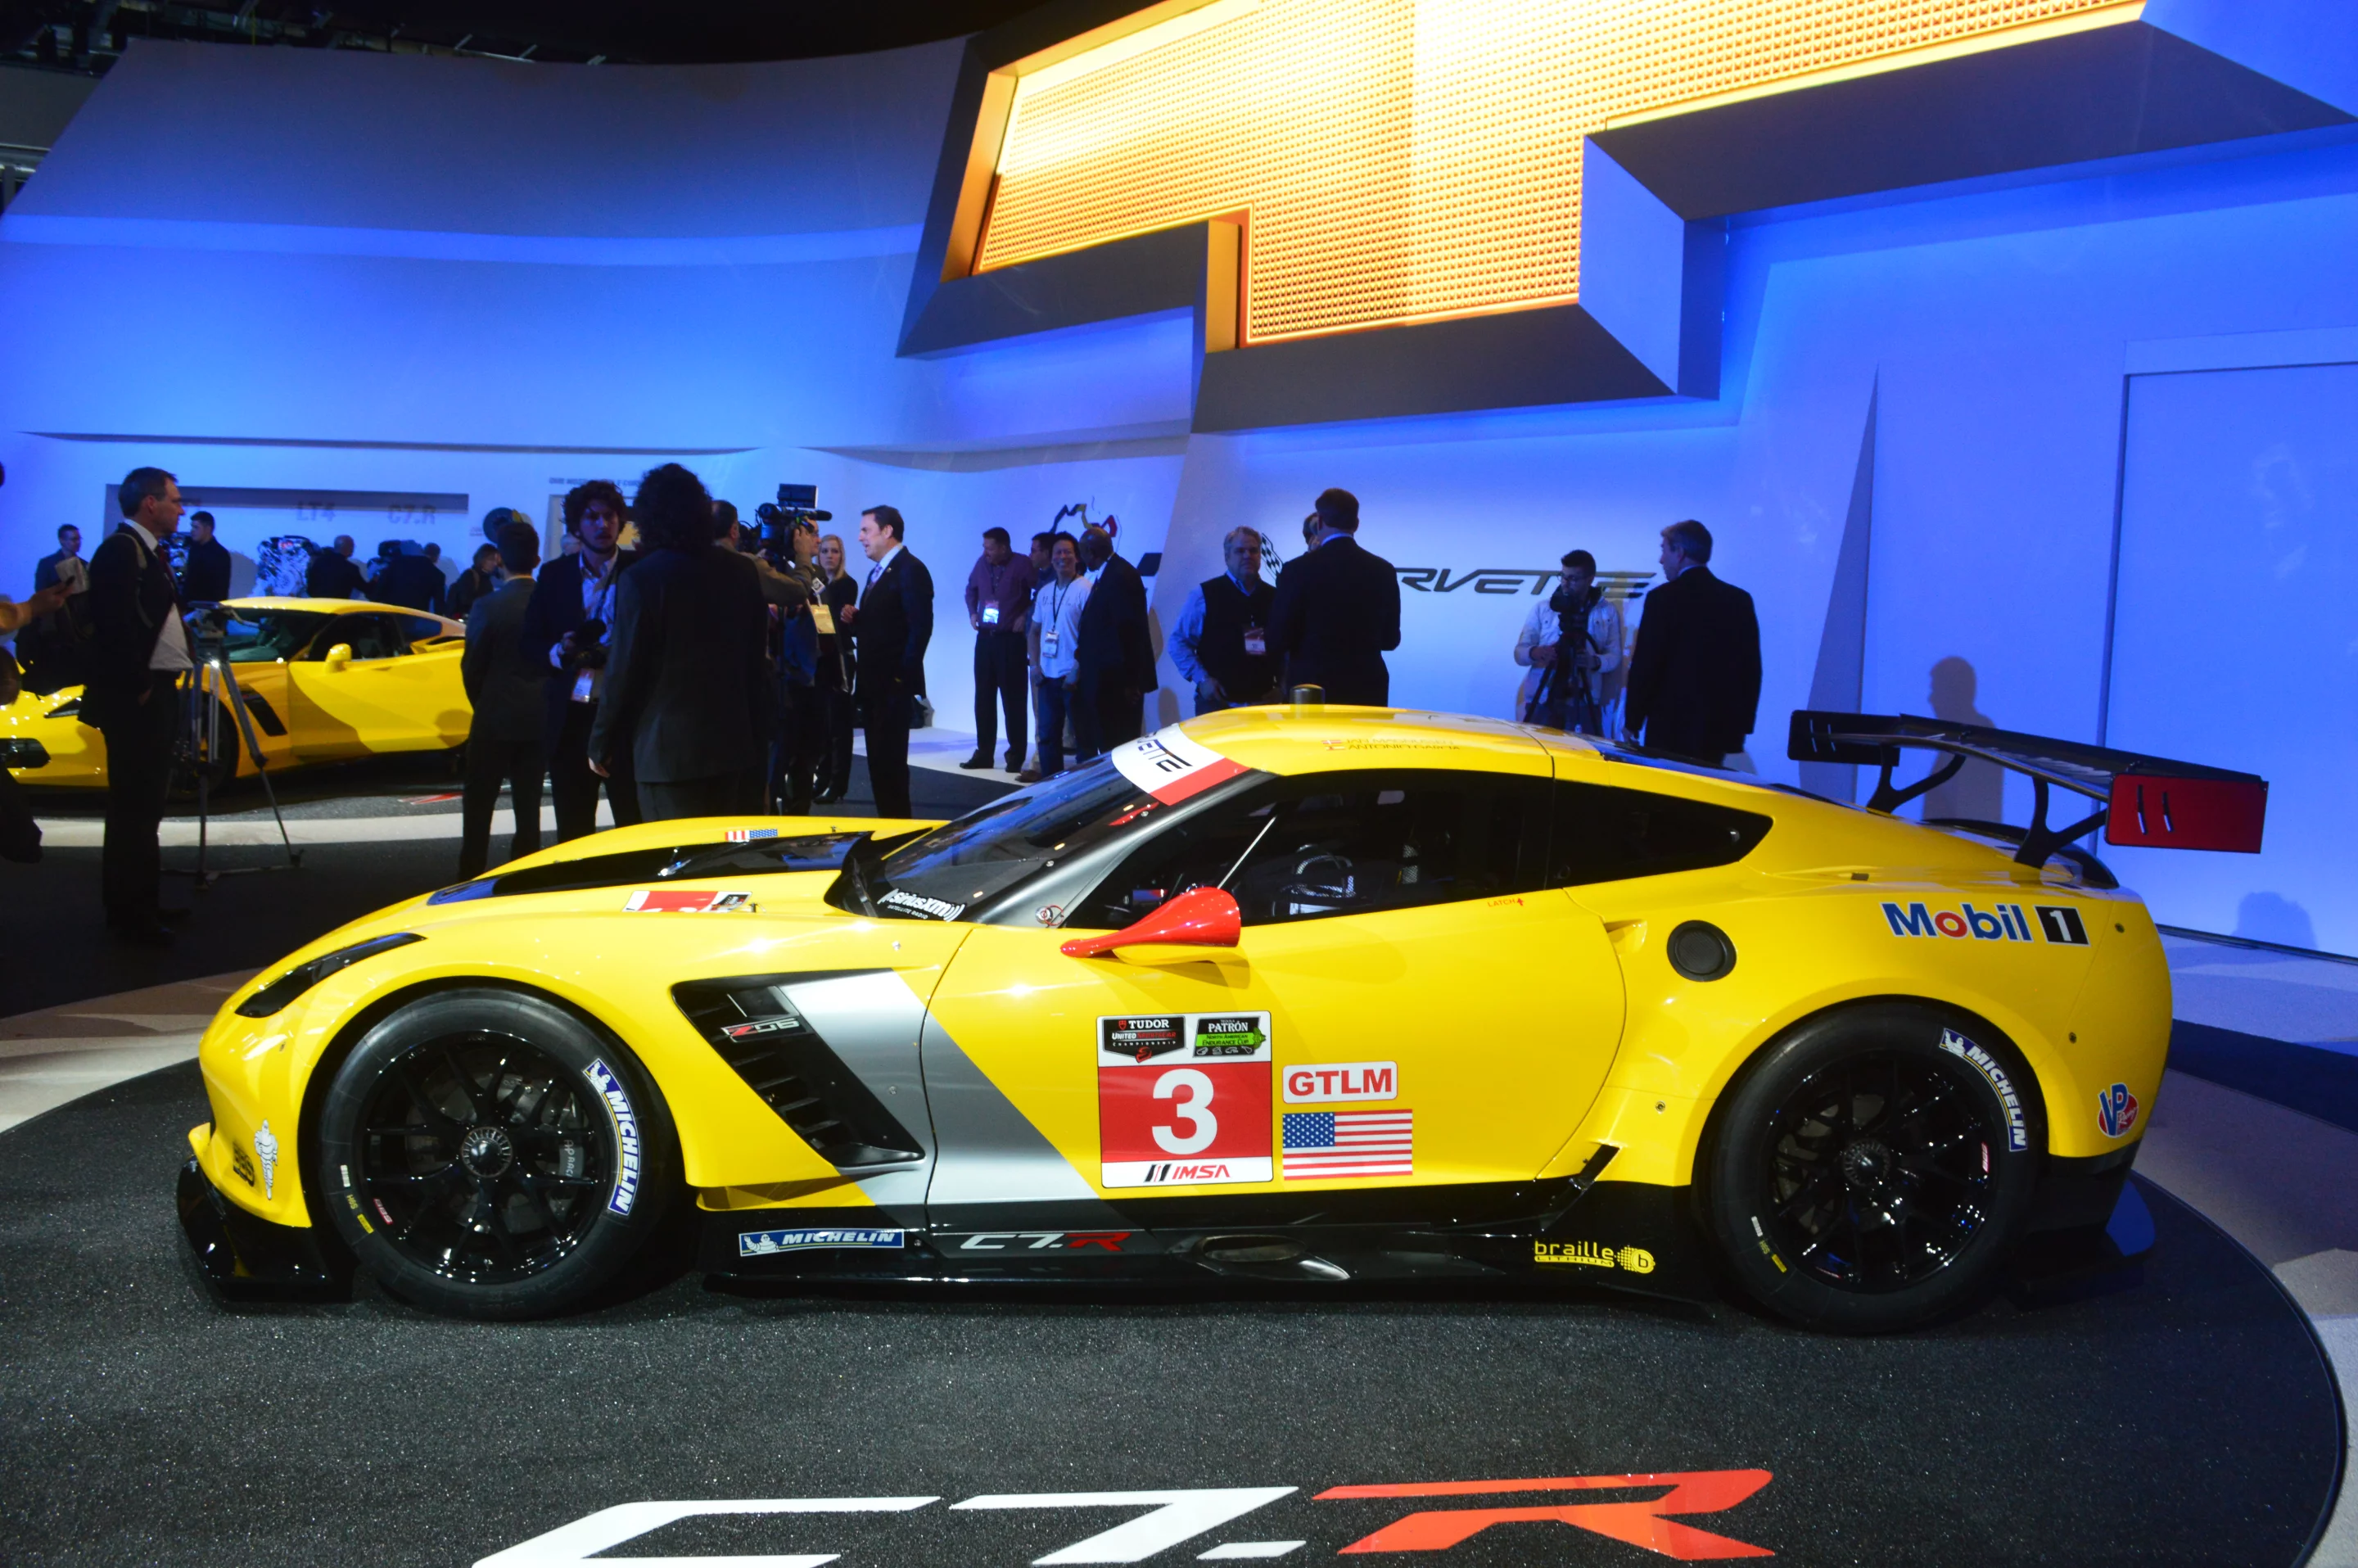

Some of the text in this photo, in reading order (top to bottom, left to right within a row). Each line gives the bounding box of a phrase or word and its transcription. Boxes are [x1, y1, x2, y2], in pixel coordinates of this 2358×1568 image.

[296, 502, 337, 522] LT4
[386, 504, 436, 525] C7.R
[1488, 898, 1516, 907] LATCH
[1881, 902, 2072, 942] Mobil 1
[728, 1018, 800, 1037] Z06
[1128, 1019, 1170, 1029] TUDOR
[1208, 1021, 1249, 1033] PATRÓN
[1111, 1032, 1136, 1040] UNITED
[1288, 1068, 1393, 1096] GTLM
[1967, 1045, 2026, 1146] MICHELIN
[1152, 1068, 1218, 1155] 3
[2098, 1082, 2128, 1136] VP
[606, 1090, 639, 1212] MICHELIN
[1172, 1164, 1231, 1180] IMSA
[782, 1231, 895, 1245] MICHELIN
[960, 1231, 1132, 1252] C7.R
[1534, 1240, 1615, 1261] braille
[1537, 1256, 1613, 1267] LITHIUM
[472, 1469, 1775, 1568] C7.R
